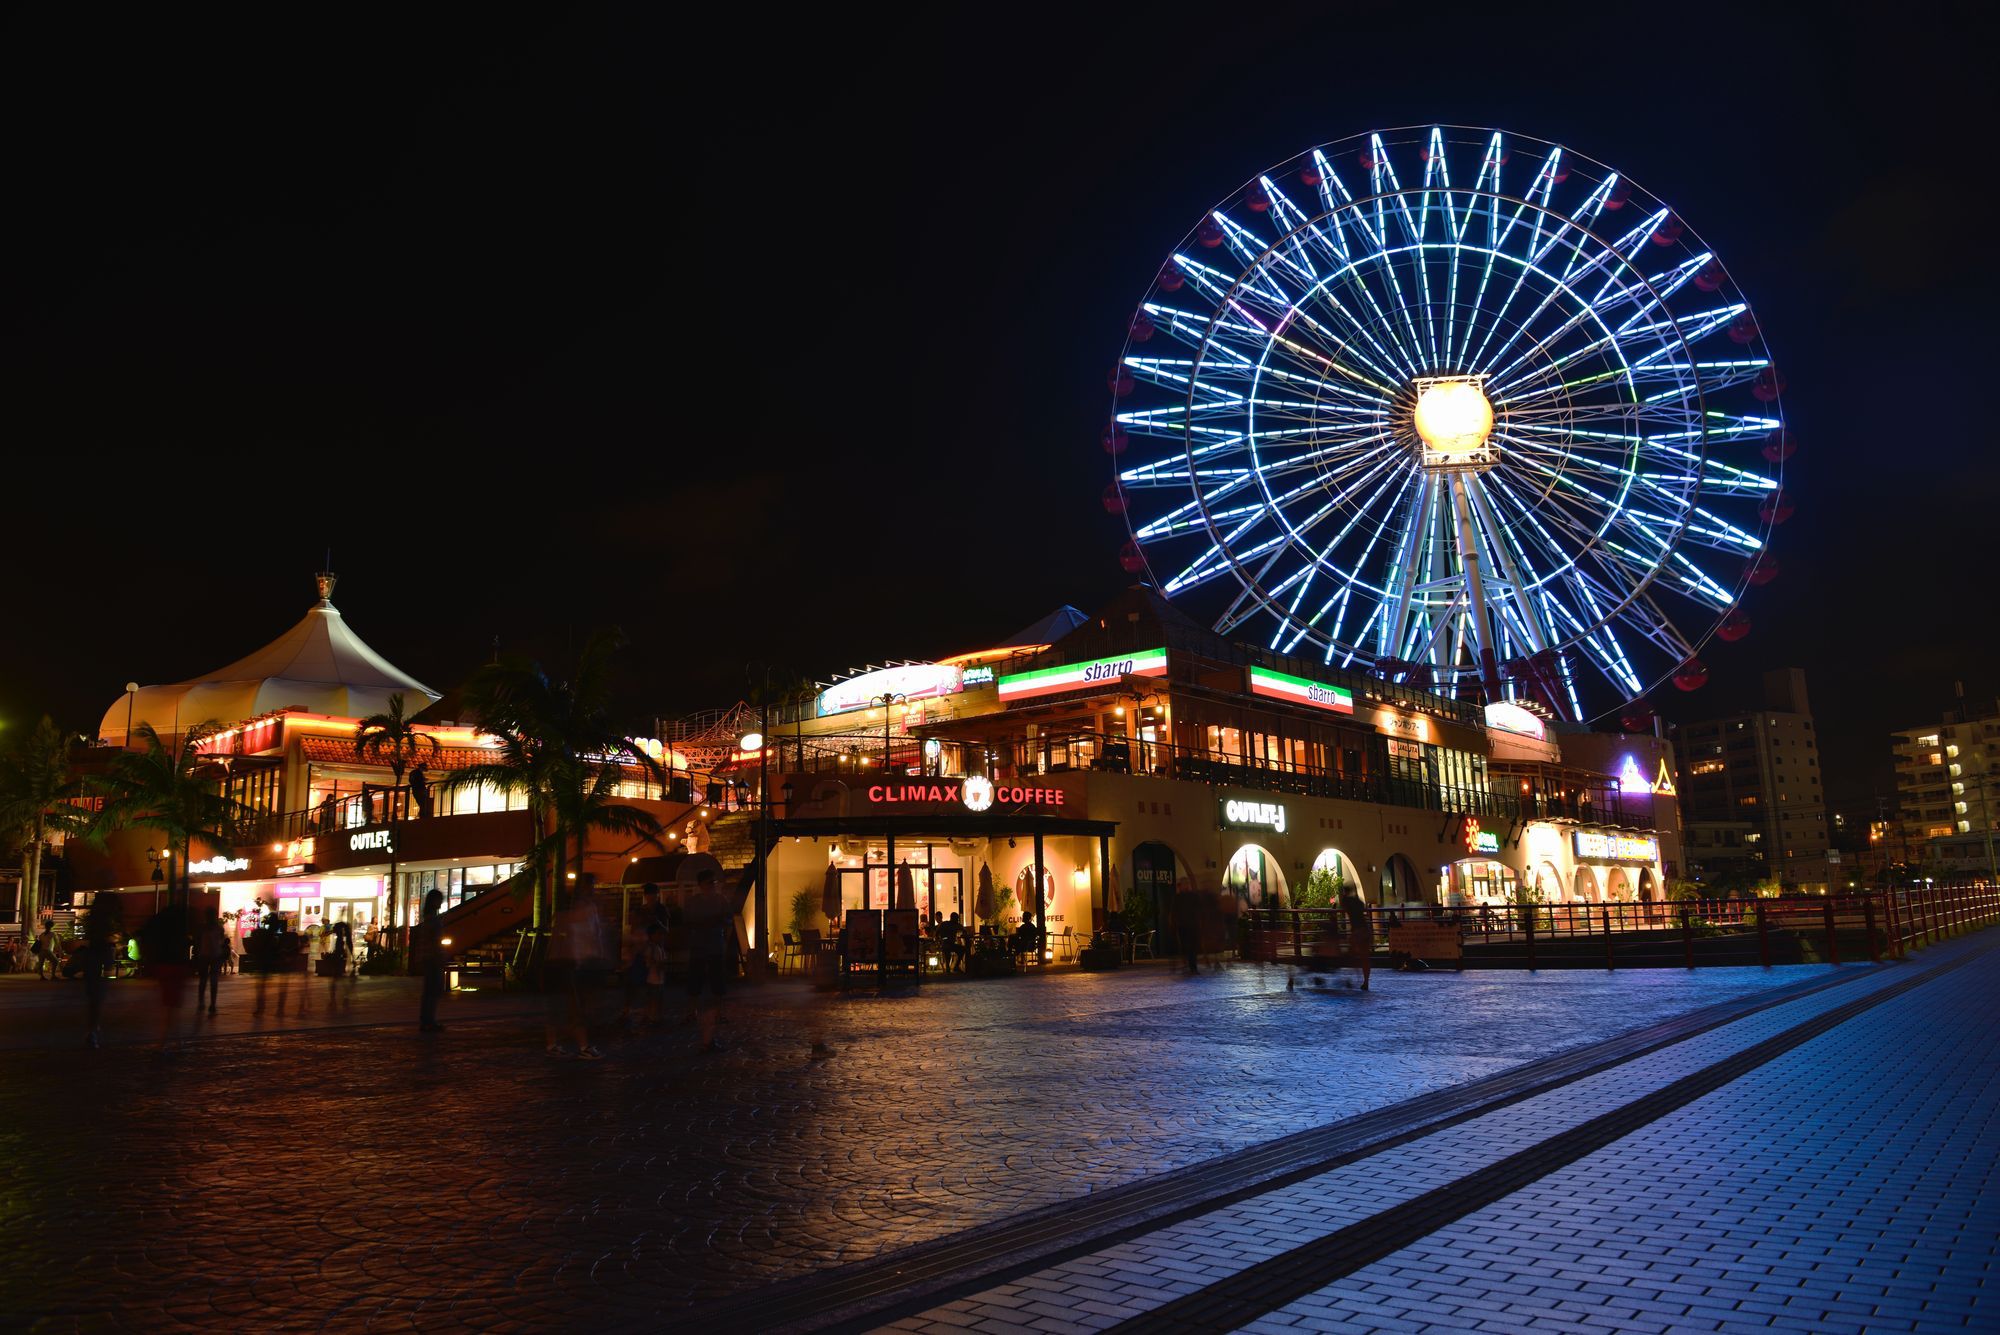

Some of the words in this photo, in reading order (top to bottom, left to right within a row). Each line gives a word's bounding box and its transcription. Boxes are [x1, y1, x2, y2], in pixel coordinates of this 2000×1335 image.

[1084, 660, 1133, 682] sbarro
[1308, 685, 1336, 704] sbarro
[868, 785, 959, 802] CLIMAX
[997, 786, 1064, 805] COFFEE
[1226, 799, 1286, 833] OUTLET-J
